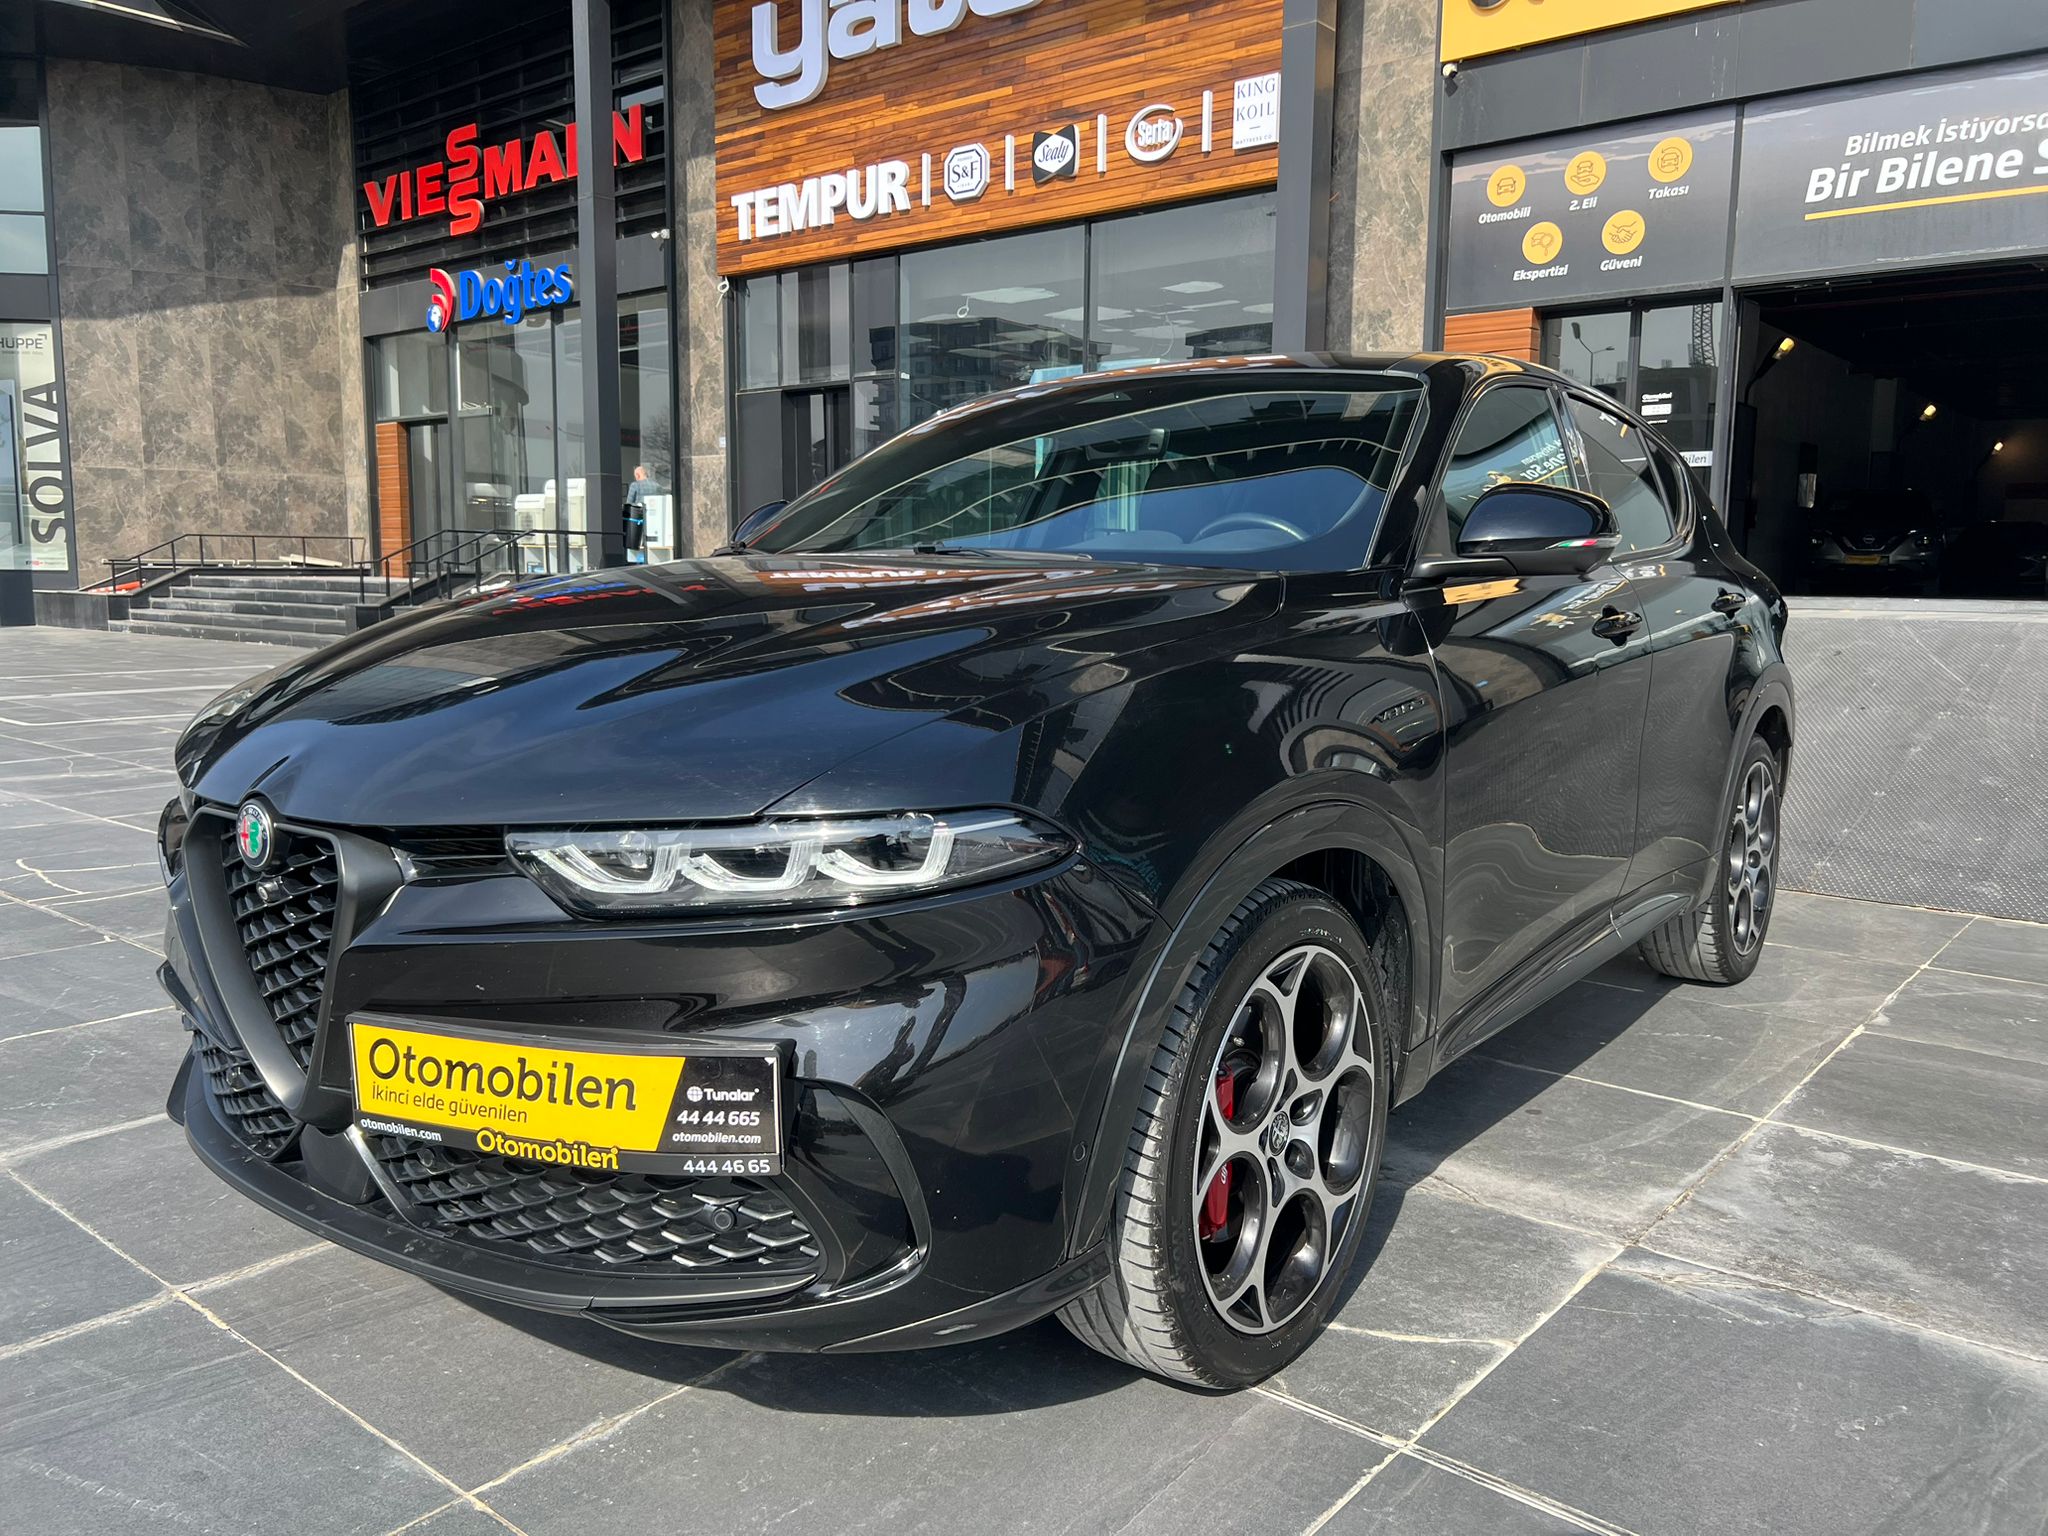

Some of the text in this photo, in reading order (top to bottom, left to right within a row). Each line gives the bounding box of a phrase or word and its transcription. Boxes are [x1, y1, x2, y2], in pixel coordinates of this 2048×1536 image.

[1237, 77, 1276, 99] KING
[1236, 101, 1275, 122] KOIL
[1137, 119, 1174, 147] Serta
[1844, 125, 1933, 157] Bilmek
[1038, 140, 1069, 163] Sealy
[951, 160, 979, 184] S&F
[1804, 163, 1870, 204] Bir
[1875, 148, 2024, 194] Bilene
[731, 160, 911, 241] TEMPUR
[1648, 185, 1690, 200] Takası
[1478, 206, 1532, 225] Otomobili
[1569, 197, 1598, 212] 2. Eli
[1512, 264, 1570, 282] Ekspertizi
[1600, 255, 1643, 272] Güveni
[459, 259, 573, 325] Doğtes
[369, 1038, 636, 1111] Otomobilen
[704, 1088, 755, 1101] Tunalar
[413, 1094, 444, 1111] elde
[449, 1099, 528, 1124] güvenilen
[677, 1110, 761, 1126] 44 44 665
[361, 1118, 442, 1141] otomobilen.com
[672, 1132, 762, 1144] otomobilen.com
[476, 1128, 619, 1169] Otomobilen
[683, 1160, 771, 1173] 444 46 65
